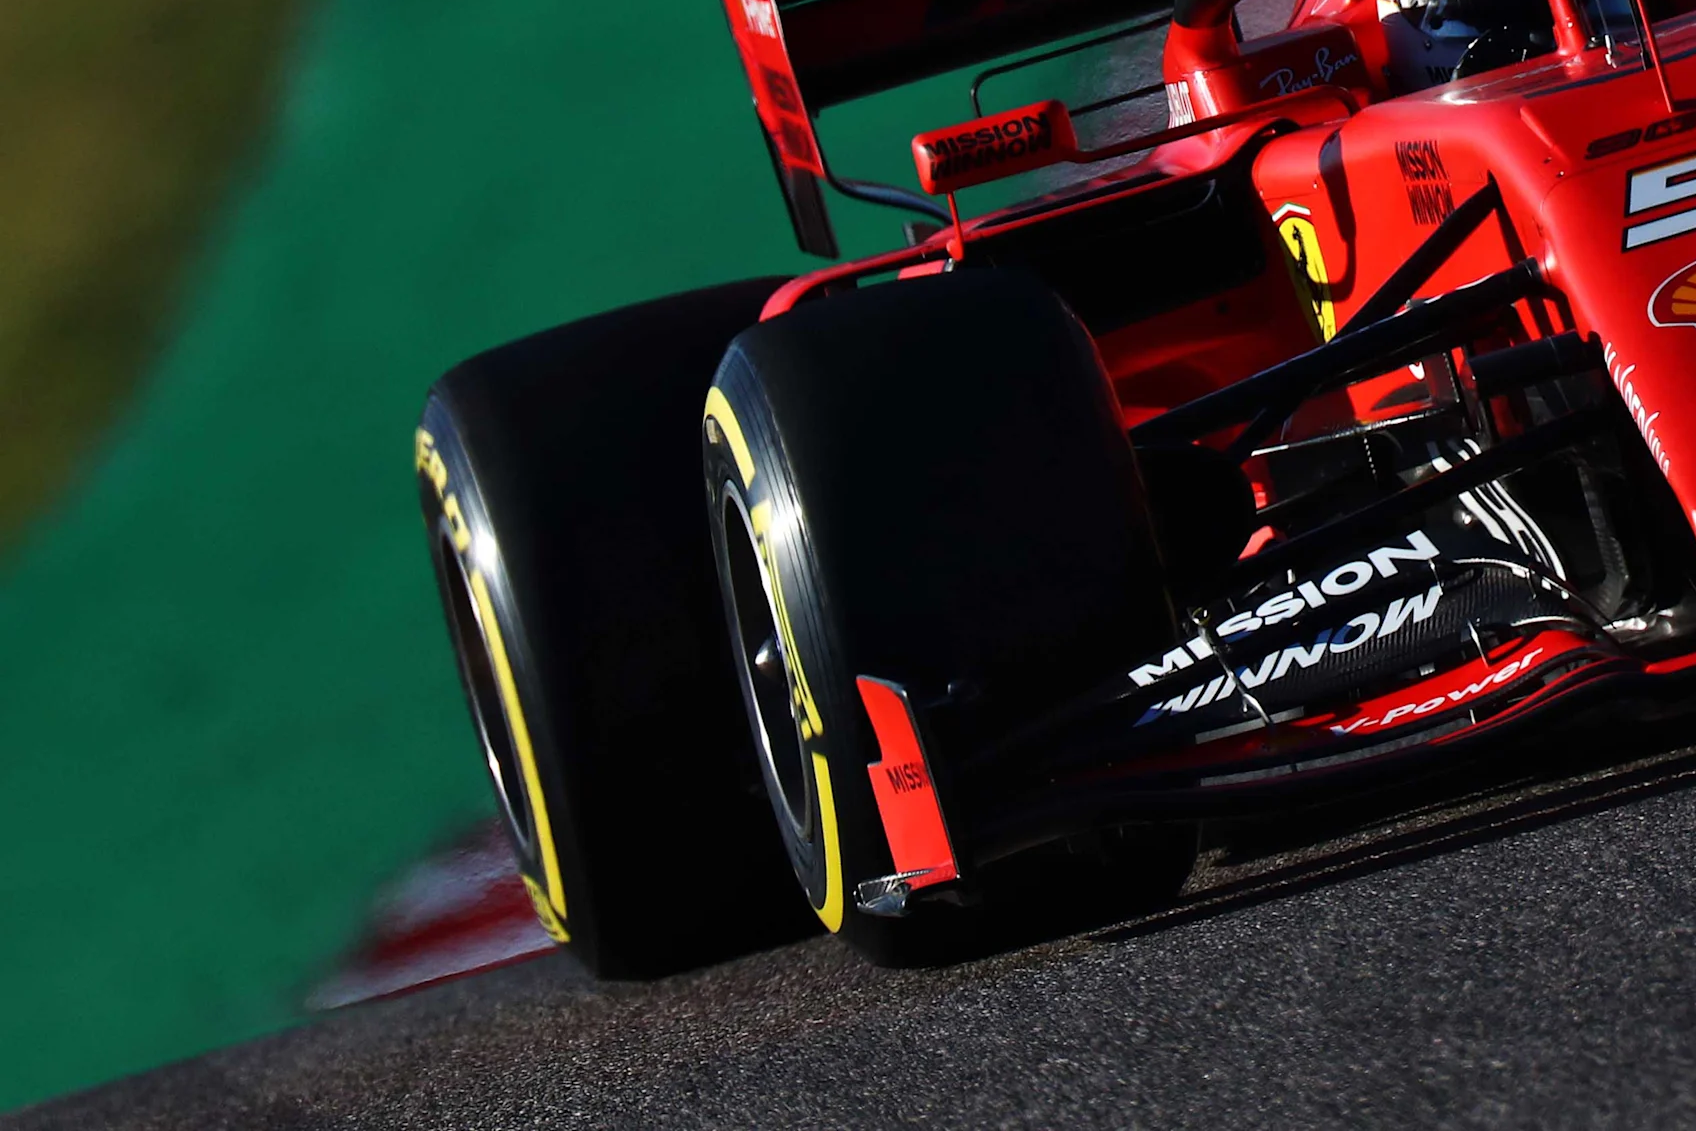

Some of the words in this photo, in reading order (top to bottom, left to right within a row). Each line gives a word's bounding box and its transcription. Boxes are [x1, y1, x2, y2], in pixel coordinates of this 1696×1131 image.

[1259, 46, 1358, 96] Ray-Ban
[924, 111, 1051, 156] MISSION
[1395, 140, 1449, 182] MISSION
[1128, 529, 1441, 689] MISSION
[1132, 585, 1445, 730] WINNOW
[1328, 647, 1544, 737] V-Power
